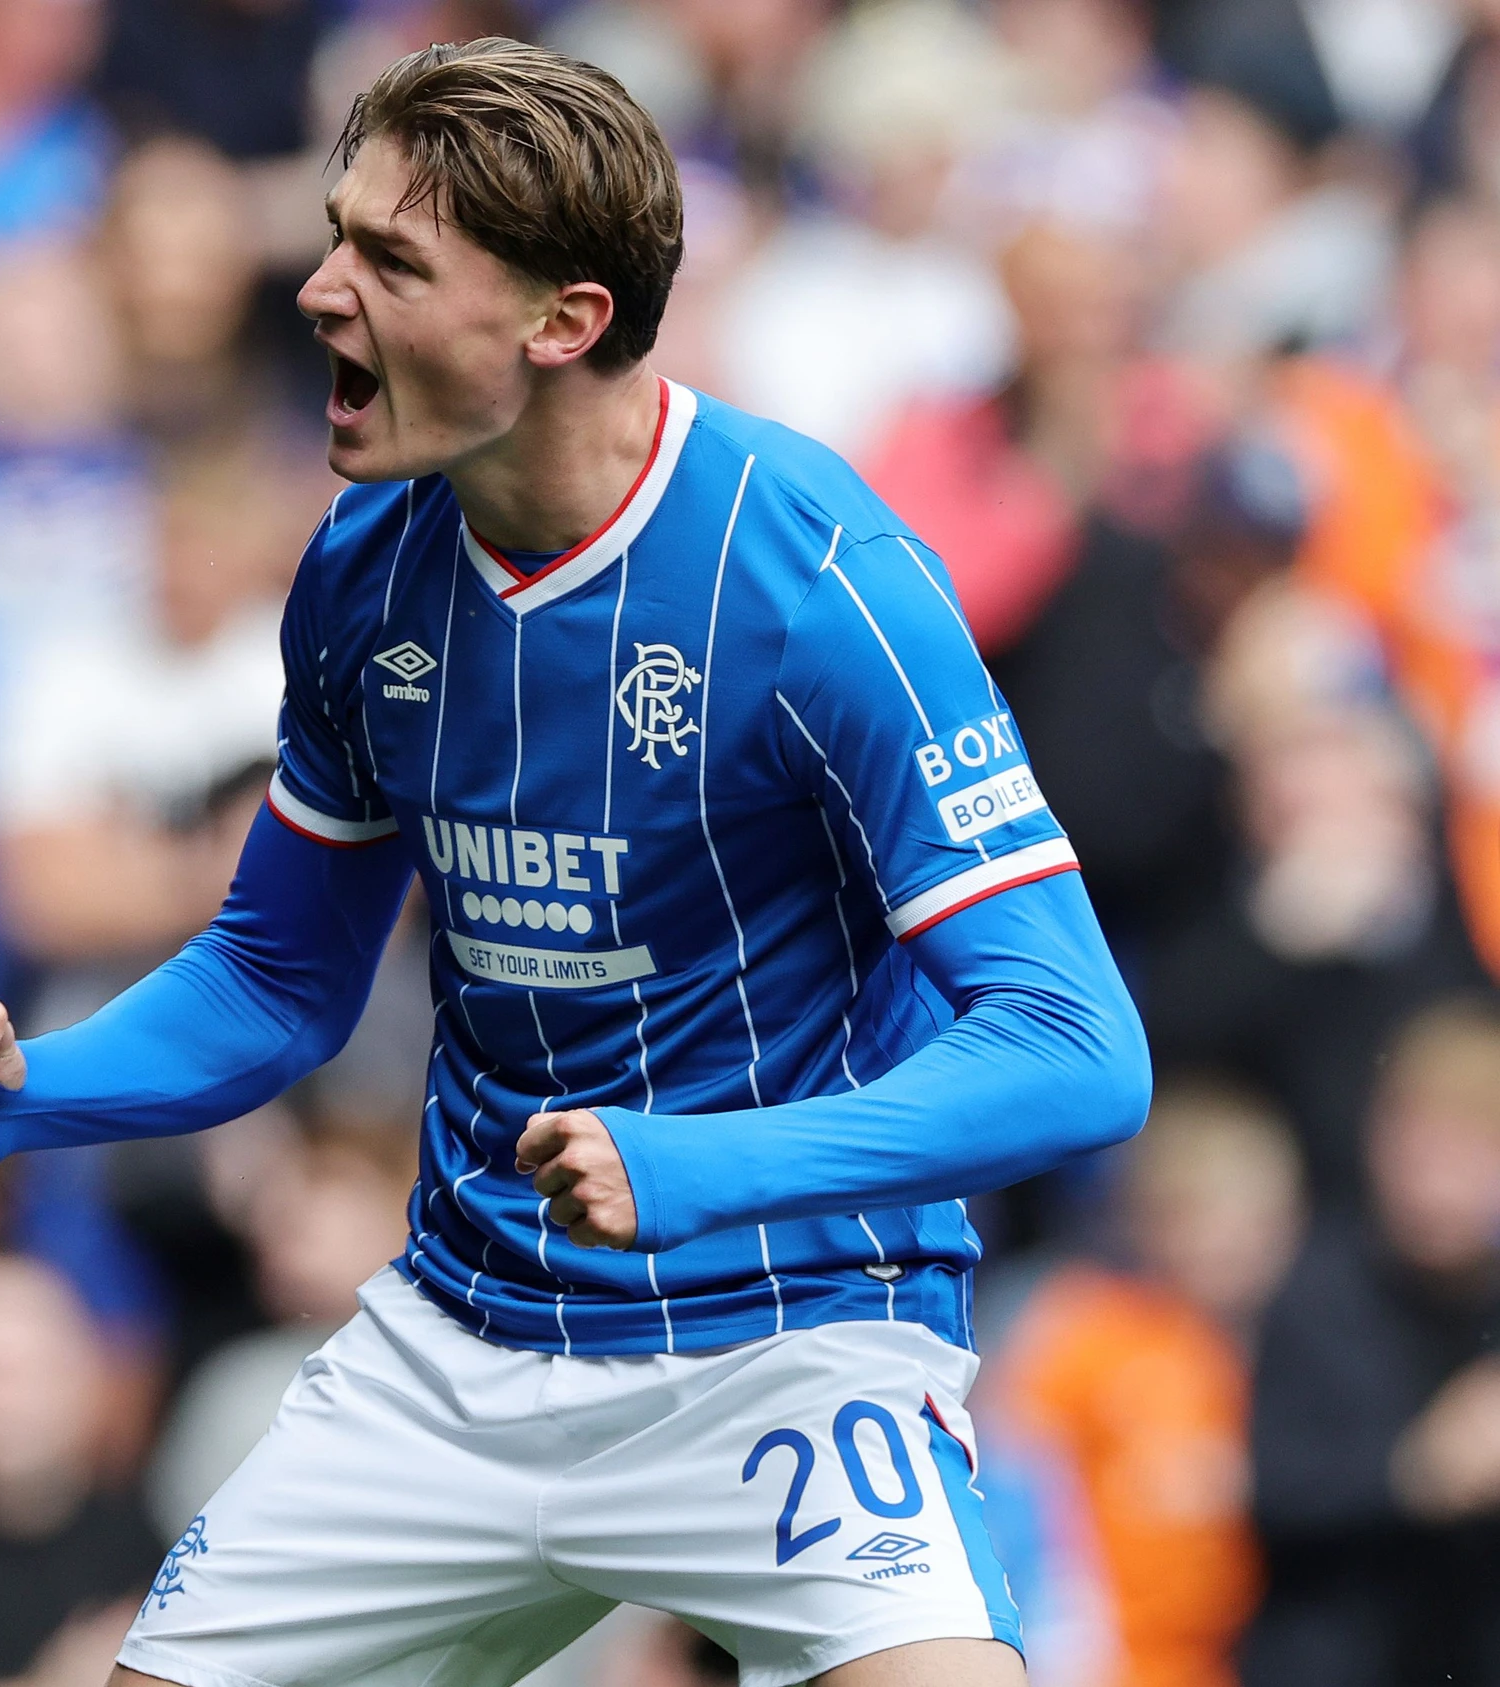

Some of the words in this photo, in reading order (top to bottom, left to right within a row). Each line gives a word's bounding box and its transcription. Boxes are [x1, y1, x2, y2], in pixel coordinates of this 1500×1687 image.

[383, 683, 430, 703] umbro
[915, 712, 1018, 788] BOXT
[422, 815, 628, 894] UNIBET
[468, 947, 492, 970] SET
[497, 952, 540, 977] YOUR
[544, 959, 608, 980] LIMITS
[742, 1400, 923, 1567] 20
[863, 1562, 930, 1581] umbro
